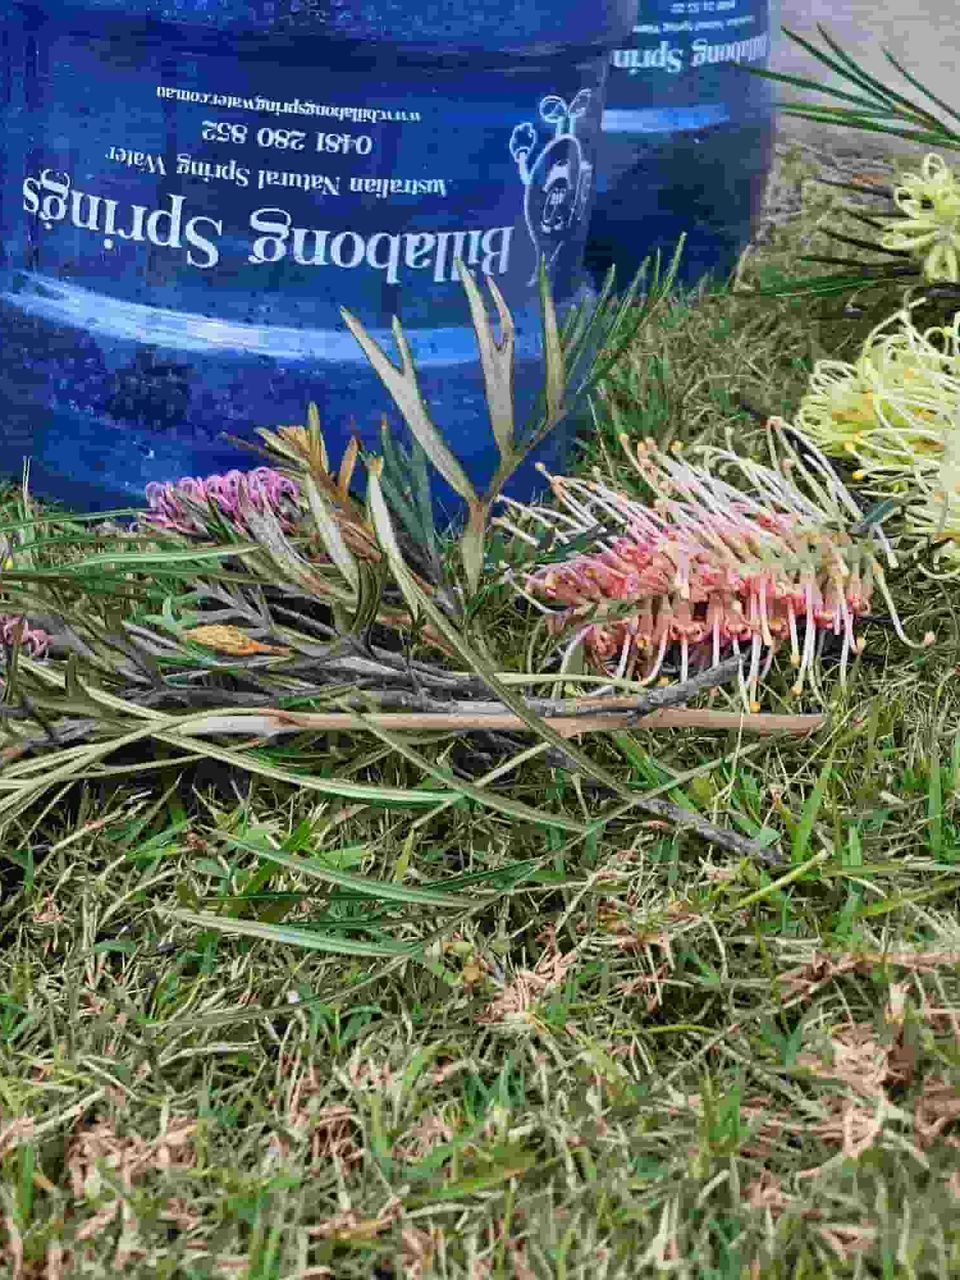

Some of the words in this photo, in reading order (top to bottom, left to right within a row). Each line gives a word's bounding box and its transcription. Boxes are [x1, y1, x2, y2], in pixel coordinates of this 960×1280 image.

[611, 40, 685, 75] Sprin
[201, 119, 248, 146] 852
[257, 127, 306, 153] 280
[315, 132, 373, 156] 0481
[105, 145, 168, 176] Water
[176, 153, 252, 188] Spring
[257, 169, 340, 196] Natural
[22, 167, 224, 269] Springs
[247, 207, 515, 284] Billabong
